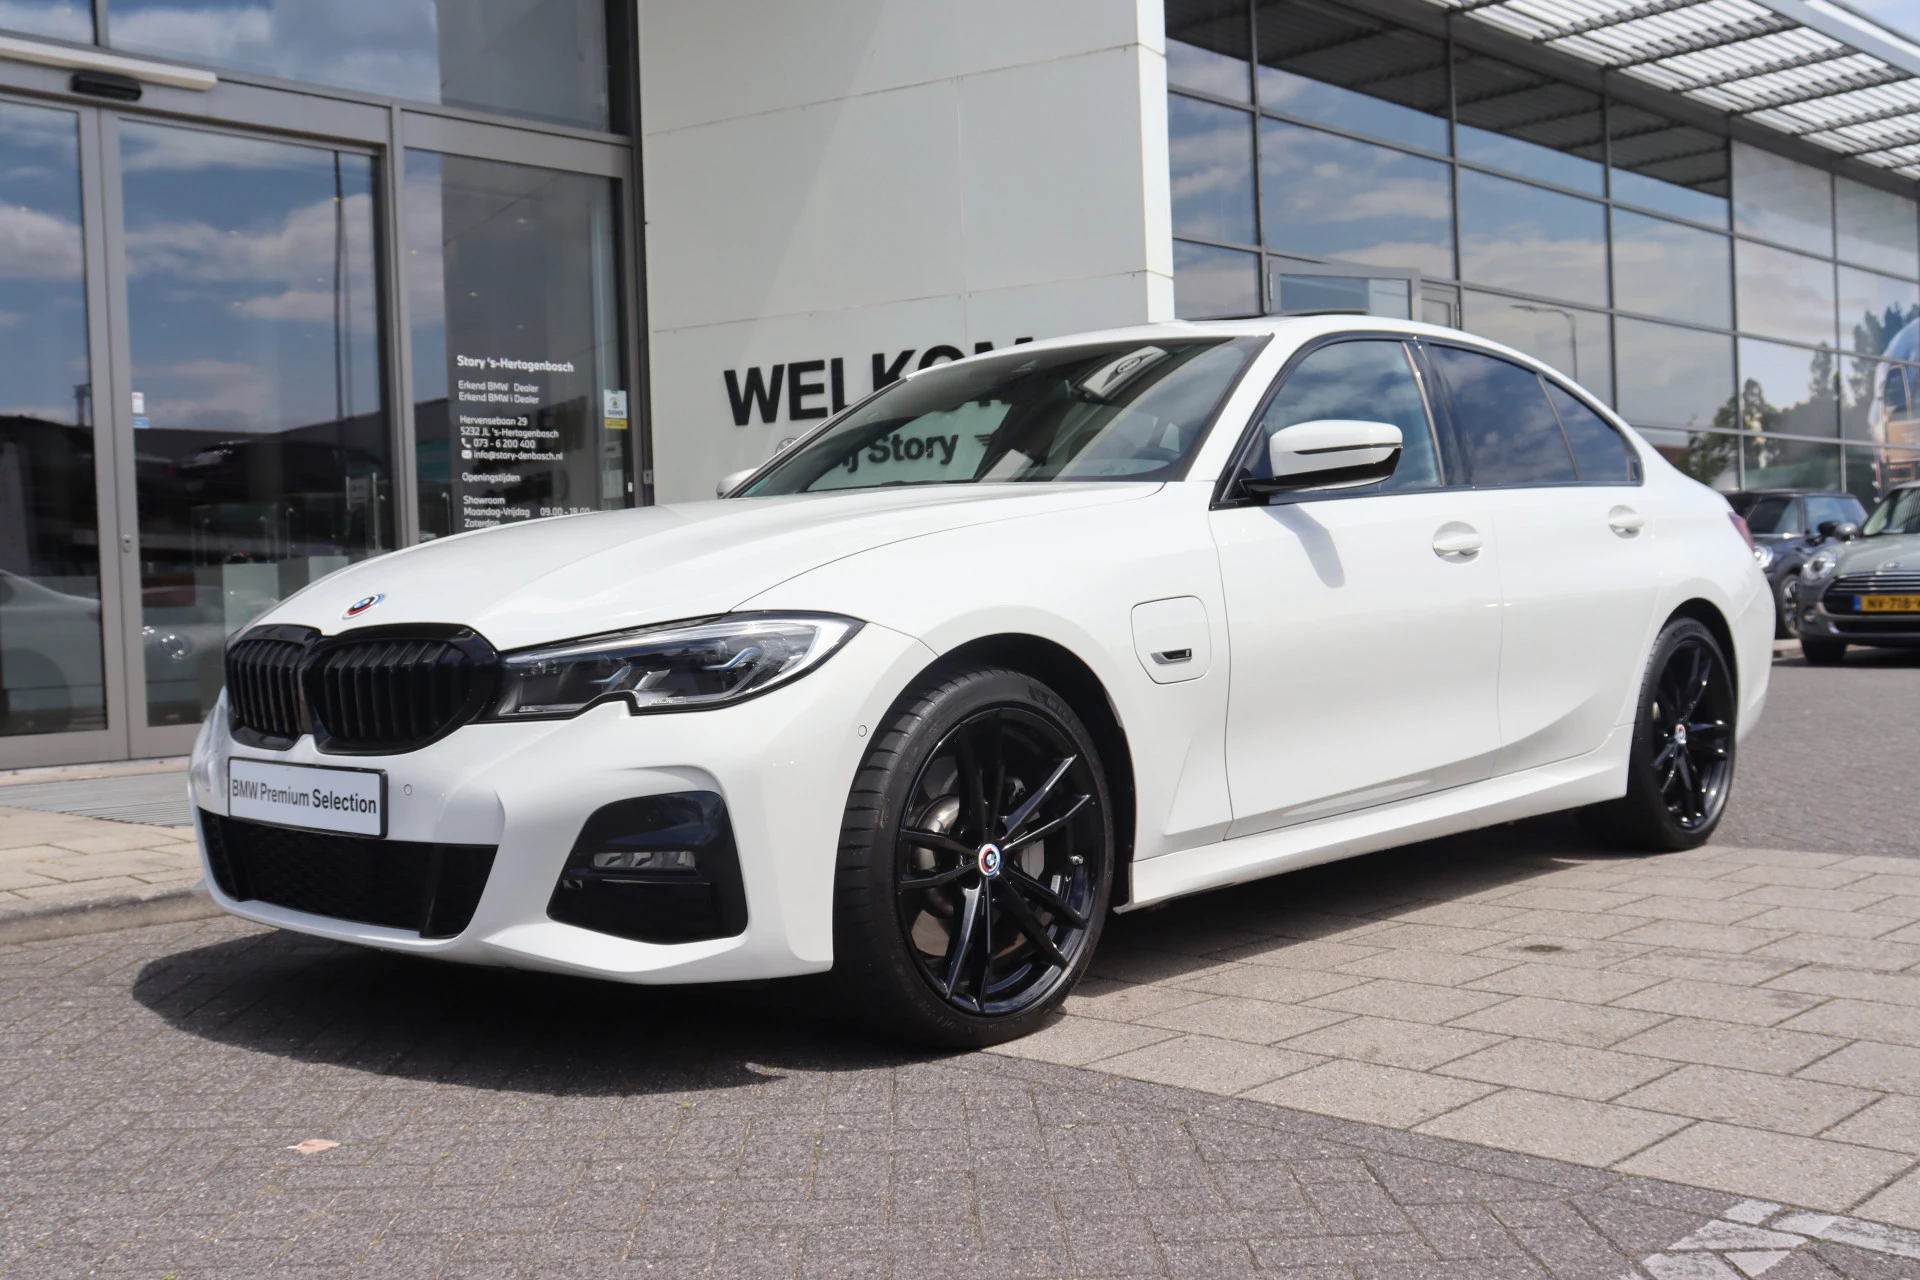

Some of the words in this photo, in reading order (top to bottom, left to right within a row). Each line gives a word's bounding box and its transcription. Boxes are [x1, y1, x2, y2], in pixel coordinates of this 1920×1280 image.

[457, 354, 486, 370] Story
[487, 357, 575, 373] 's-Hertogenbosch
[458, 380, 486, 390] Erkend
[487, 382, 509, 391] BMW
[513, 383, 539, 393] Dealer
[724, 336, 1033, 426] WELK
[458, 392, 487, 402] Erkend
[488, 393, 508, 402] BMW
[514, 394, 539, 404] Dealer
[460, 415, 516, 426] Hervensebaan
[517, 417, 528, 426] 29
[460, 426, 480, 436] 5232
[482, 428, 490, 437] JL
[491, 428, 559, 439] 's-Hertogenbosch
[473, 438, 488, 448] 073
[495, 440, 501, 448] 6
[502, 440, 518, 449] 200
[519, 440, 536, 449] 400
[867, 433, 959, 466] Story
[473, 450, 563, 461] info@story-denbosch.nl
[462, 472, 521, 483] Openingstijden
[463, 495, 506, 505] Showroom
[463, 507, 530, 517] Maandag-Vrijdag
[539, 507, 563, 516] 09.00
[1867, 598, 1920, 609] NV-718-
[232, 779, 259, 799] BMW
[260, 783, 310, 807] Premium
[312, 788, 377, 814] Selection
